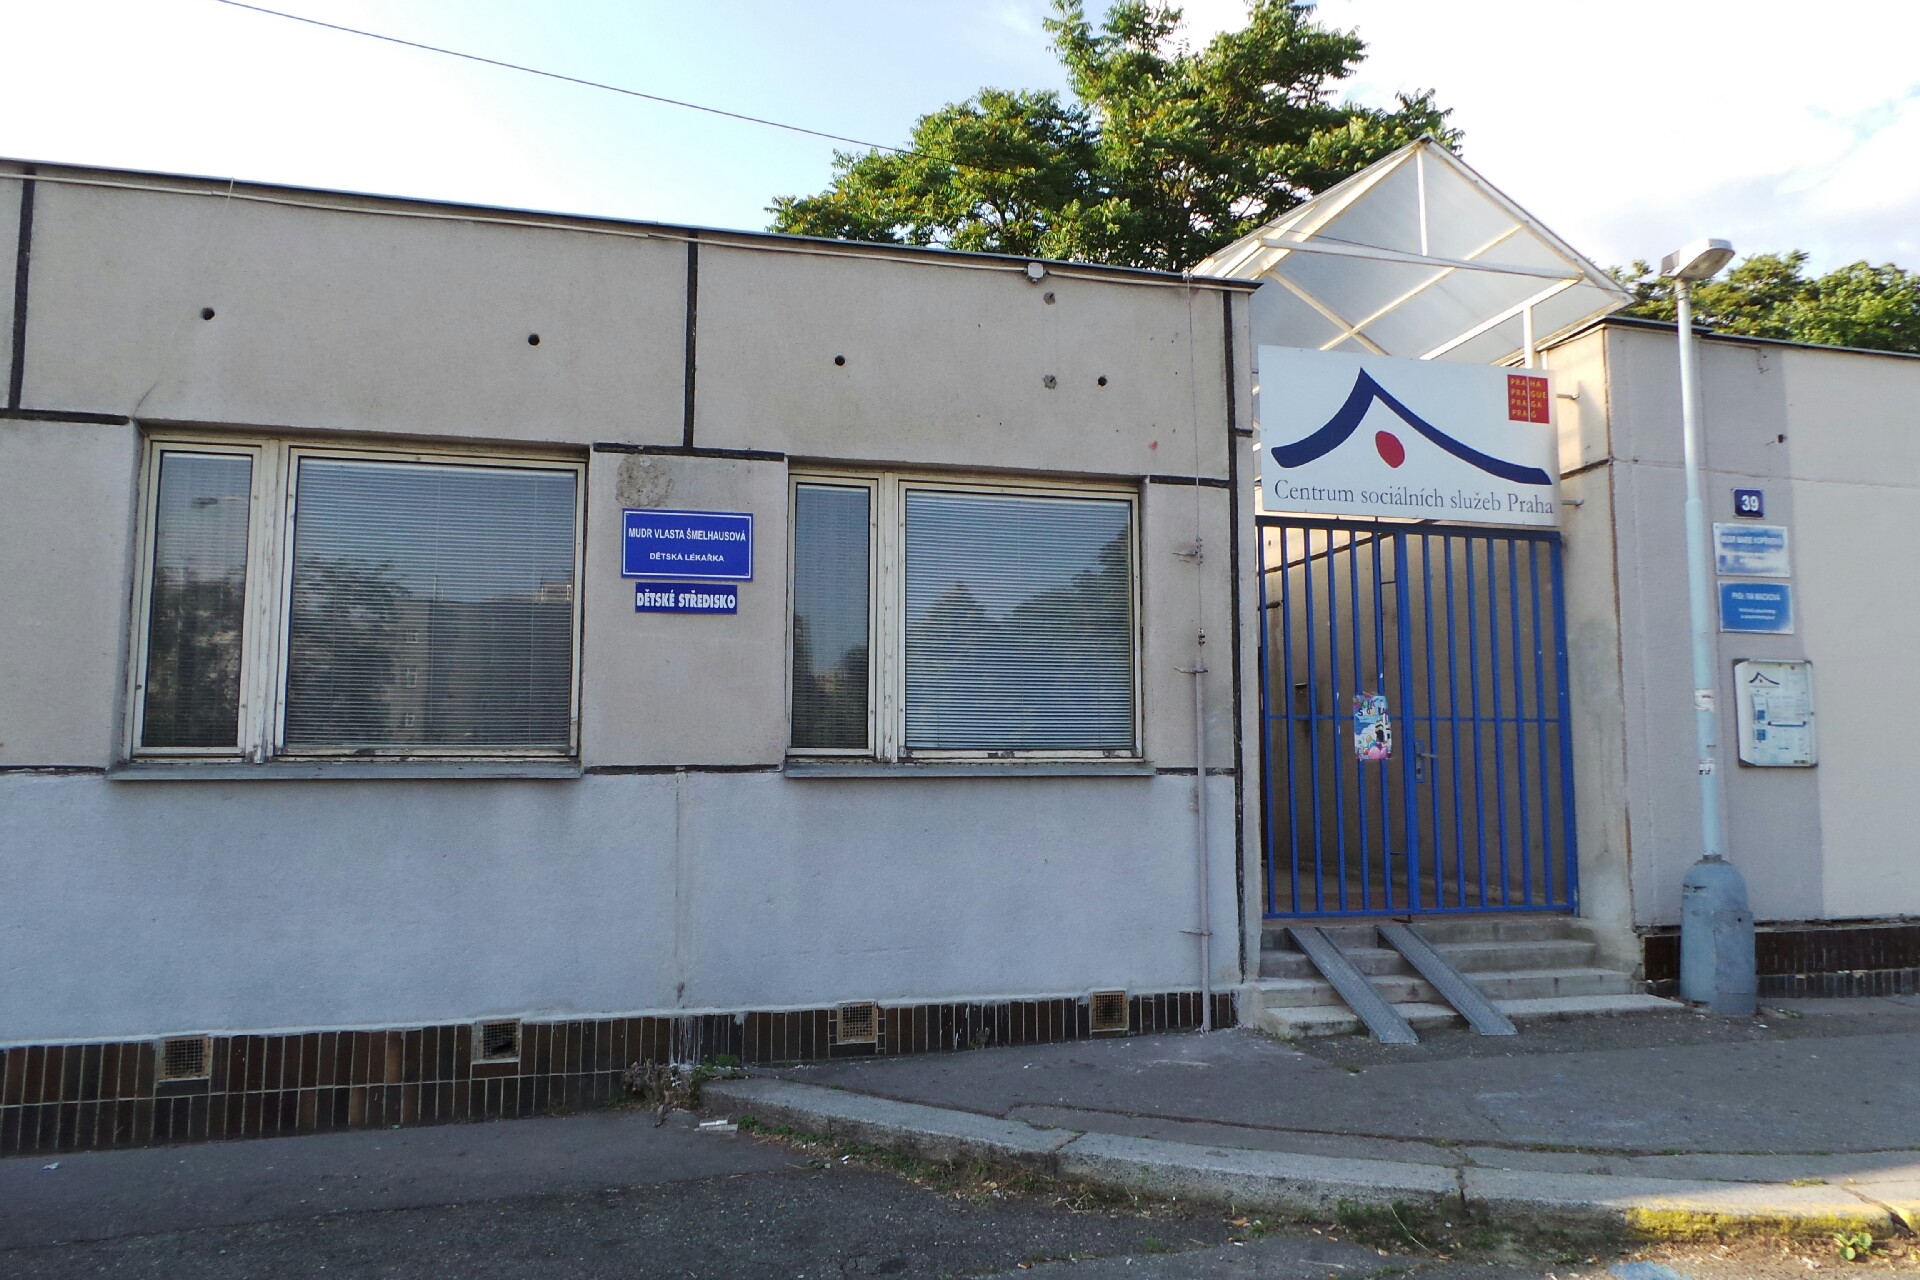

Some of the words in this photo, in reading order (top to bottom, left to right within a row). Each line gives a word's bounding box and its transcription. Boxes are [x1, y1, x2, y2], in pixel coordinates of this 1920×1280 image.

[1274, 479, 1354, 503] Centrum
[1360, 485, 1444, 508] sociálních
[1450, 490, 1501, 511] služeb
[1507, 493, 1554, 514] Praha
[1741, 494, 1759, 512] 39
[628, 527, 652, 539] MUDR
[654, 529, 685, 539] VLASTA
[686, 528, 746, 542] ŠMELHAUSOVÁ
[649, 551, 683, 561] DĚTSKÁ
[684, 552, 725, 562] LÉKAŘKA
[636, 588, 675, 607] DĚTSKÉ
[678, 590, 736, 609] STŘEDISKO
